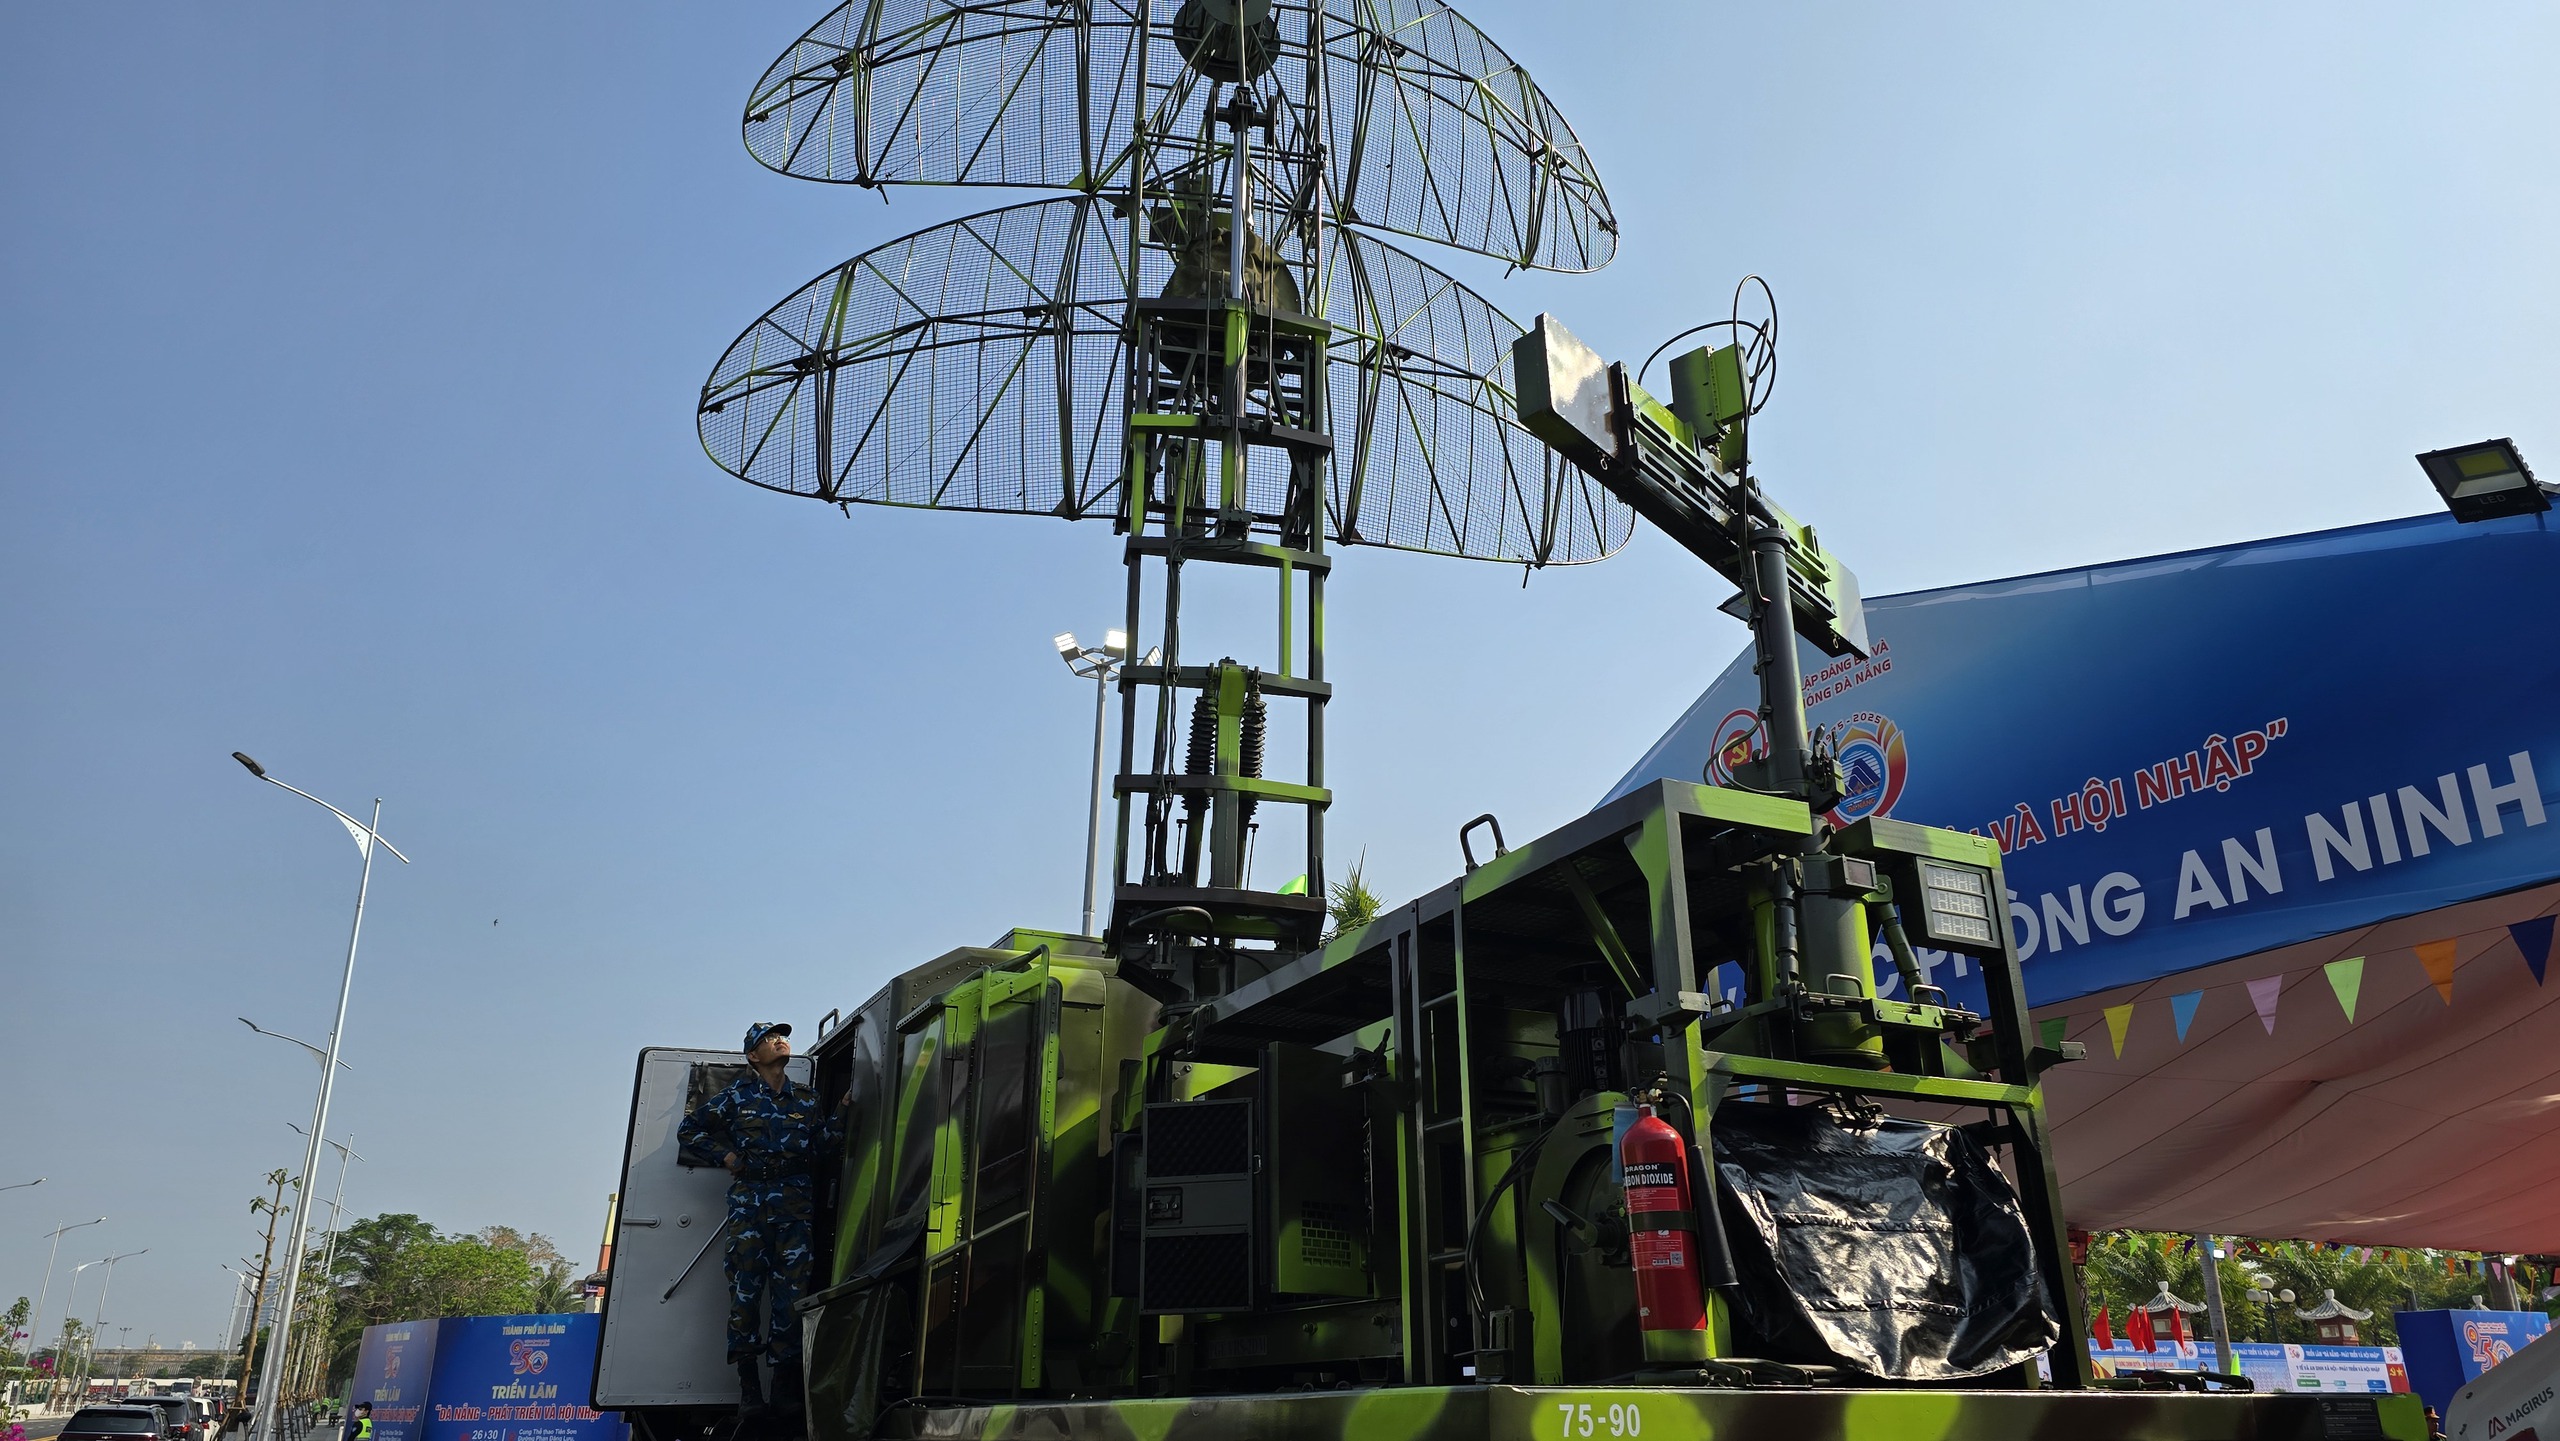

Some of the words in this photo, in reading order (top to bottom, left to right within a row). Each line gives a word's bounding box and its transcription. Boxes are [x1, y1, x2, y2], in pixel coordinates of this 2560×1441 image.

[1820, 658, 1852, 682] ĐẢNG
[1871, 639, 1889, 656] VÀ
[1803, 686, 1832, 708] ÓNG
[1834, 676, 1853, 695] ĐÀ
[1855, 659, 1892, 685] NẴNG
[1852, 711, 1882, 725] 2025
[1988, 802, 2047, 855] VÀ
[2050, 776, 2127, 833] HỘI
[2173, 826, 2284, 920] AN
[2304, 750, 2548, 882] NINH
[1625, 1164, 1658, 1173] DRAGON
[1641, 1173, 1674, 1185] DIOXIDE
[491, 1377, 527, 1400] TRIỂN
[528, 1381, 558, 1399] LÃM
[452, 1402, 480, 1421] NẴNG
[487, 1404, 513, 1421] PHÁT
[513, 1401, 542, 1421] TRIỂN
[543, 1403, 557, 1421] VÀ
[557, 1403, 576, 1423] HỘI
[1558, 1403, 1641, 1438] 75-90
[2505, 1386, 2554, 1427] MAGIRUS
